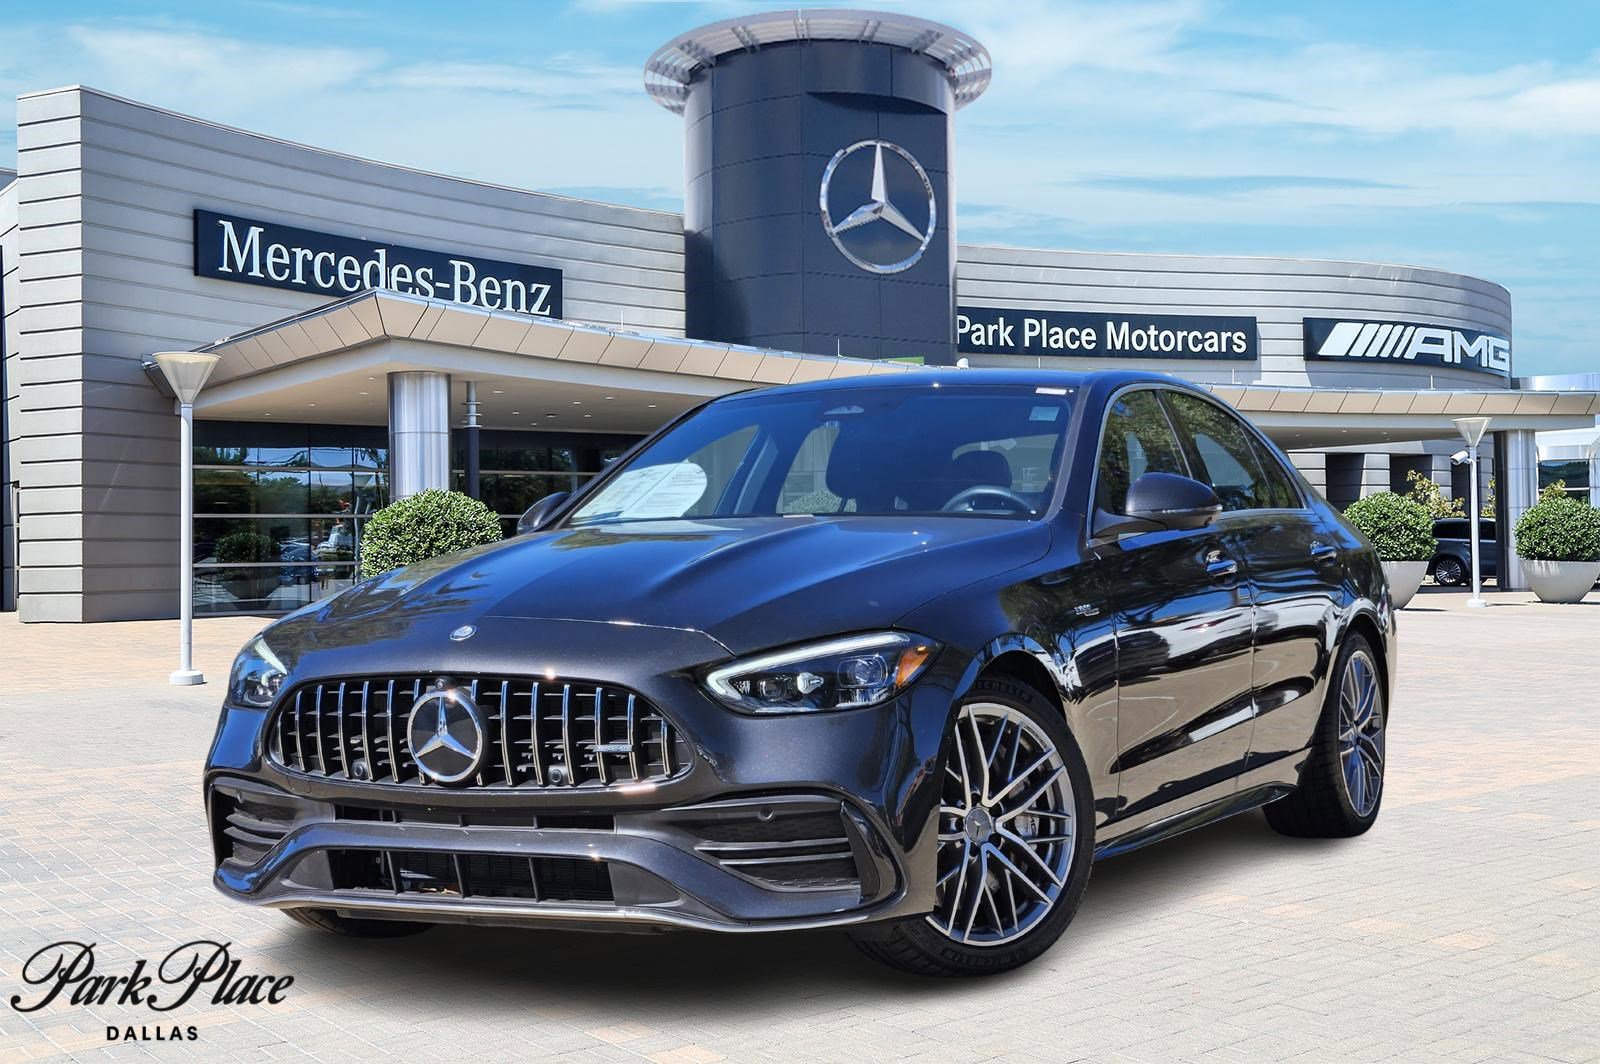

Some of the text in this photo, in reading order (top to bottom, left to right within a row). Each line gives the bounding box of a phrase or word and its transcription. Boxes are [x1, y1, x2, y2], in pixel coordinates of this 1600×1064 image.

[218, 219, 551, 316] Mercedes-Benz
[956, 314, 1247, 354] Park Place Motorcars
